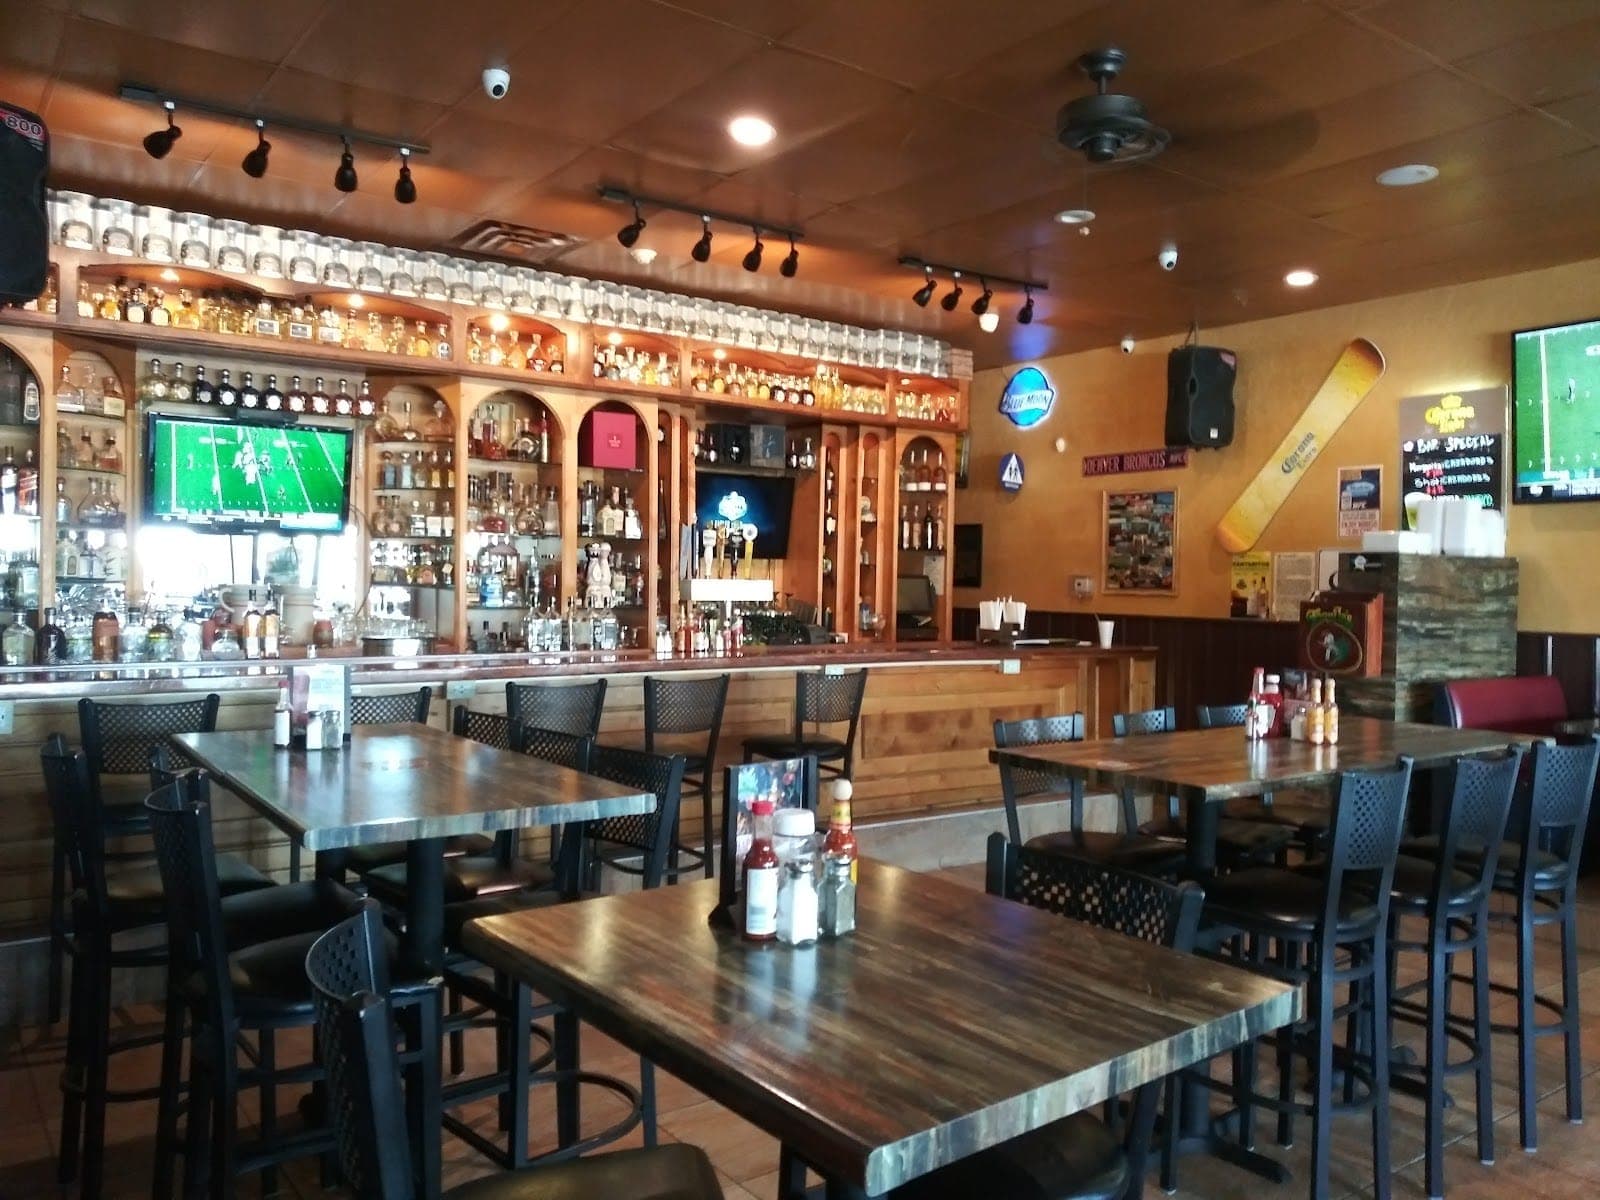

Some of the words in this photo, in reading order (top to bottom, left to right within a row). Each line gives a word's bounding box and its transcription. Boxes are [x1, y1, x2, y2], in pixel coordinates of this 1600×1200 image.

[1003, 394, 1025, 409] BLUE
[1026, 391, 1050, 407] MOON
[1281, 432, 1314, 474] Corona
[1445, 434, 1495, 453] SPECIAL
[1086, 456, 1120, 474] DENVER
[1123, 451, 1166, 472] BRONCOS
